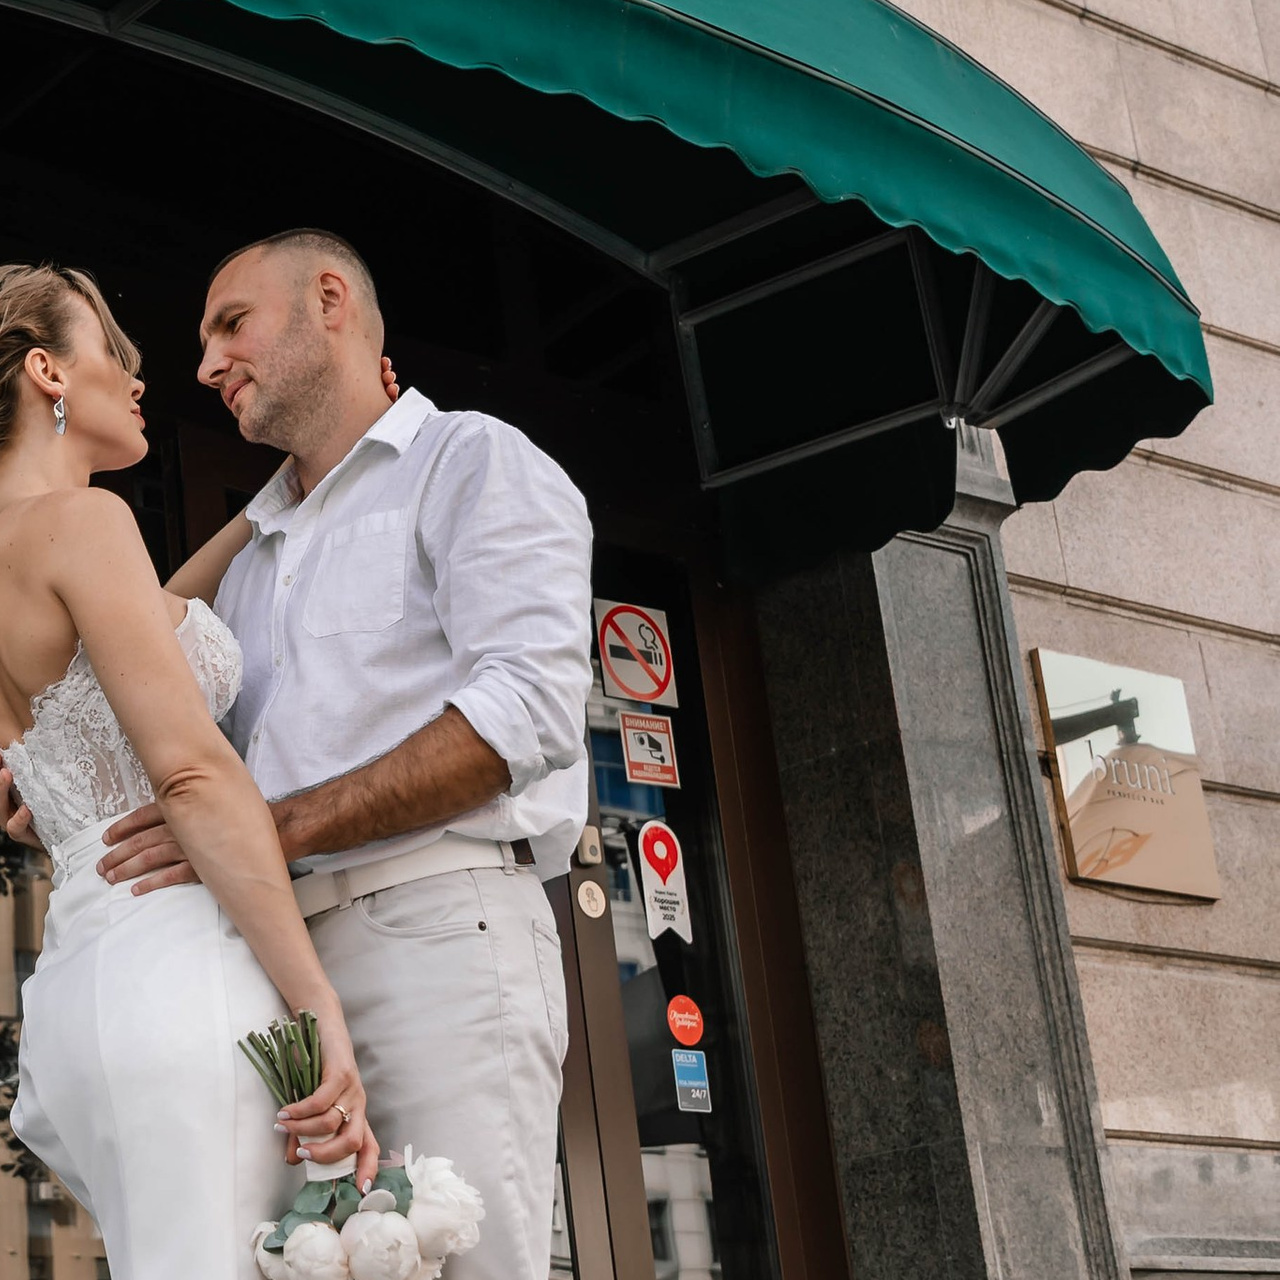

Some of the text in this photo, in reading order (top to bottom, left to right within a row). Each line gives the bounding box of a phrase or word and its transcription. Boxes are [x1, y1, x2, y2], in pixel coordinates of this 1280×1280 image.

[625, 717, 666, 731] ВНИМАНИЕ!
[1084, 739, 1176, 797] bruni
[654, 897, 680, 905] Хорошее
[676, 1053, 697, 1063] DELTA
[691, 1089, 706, 1099] 24/7
